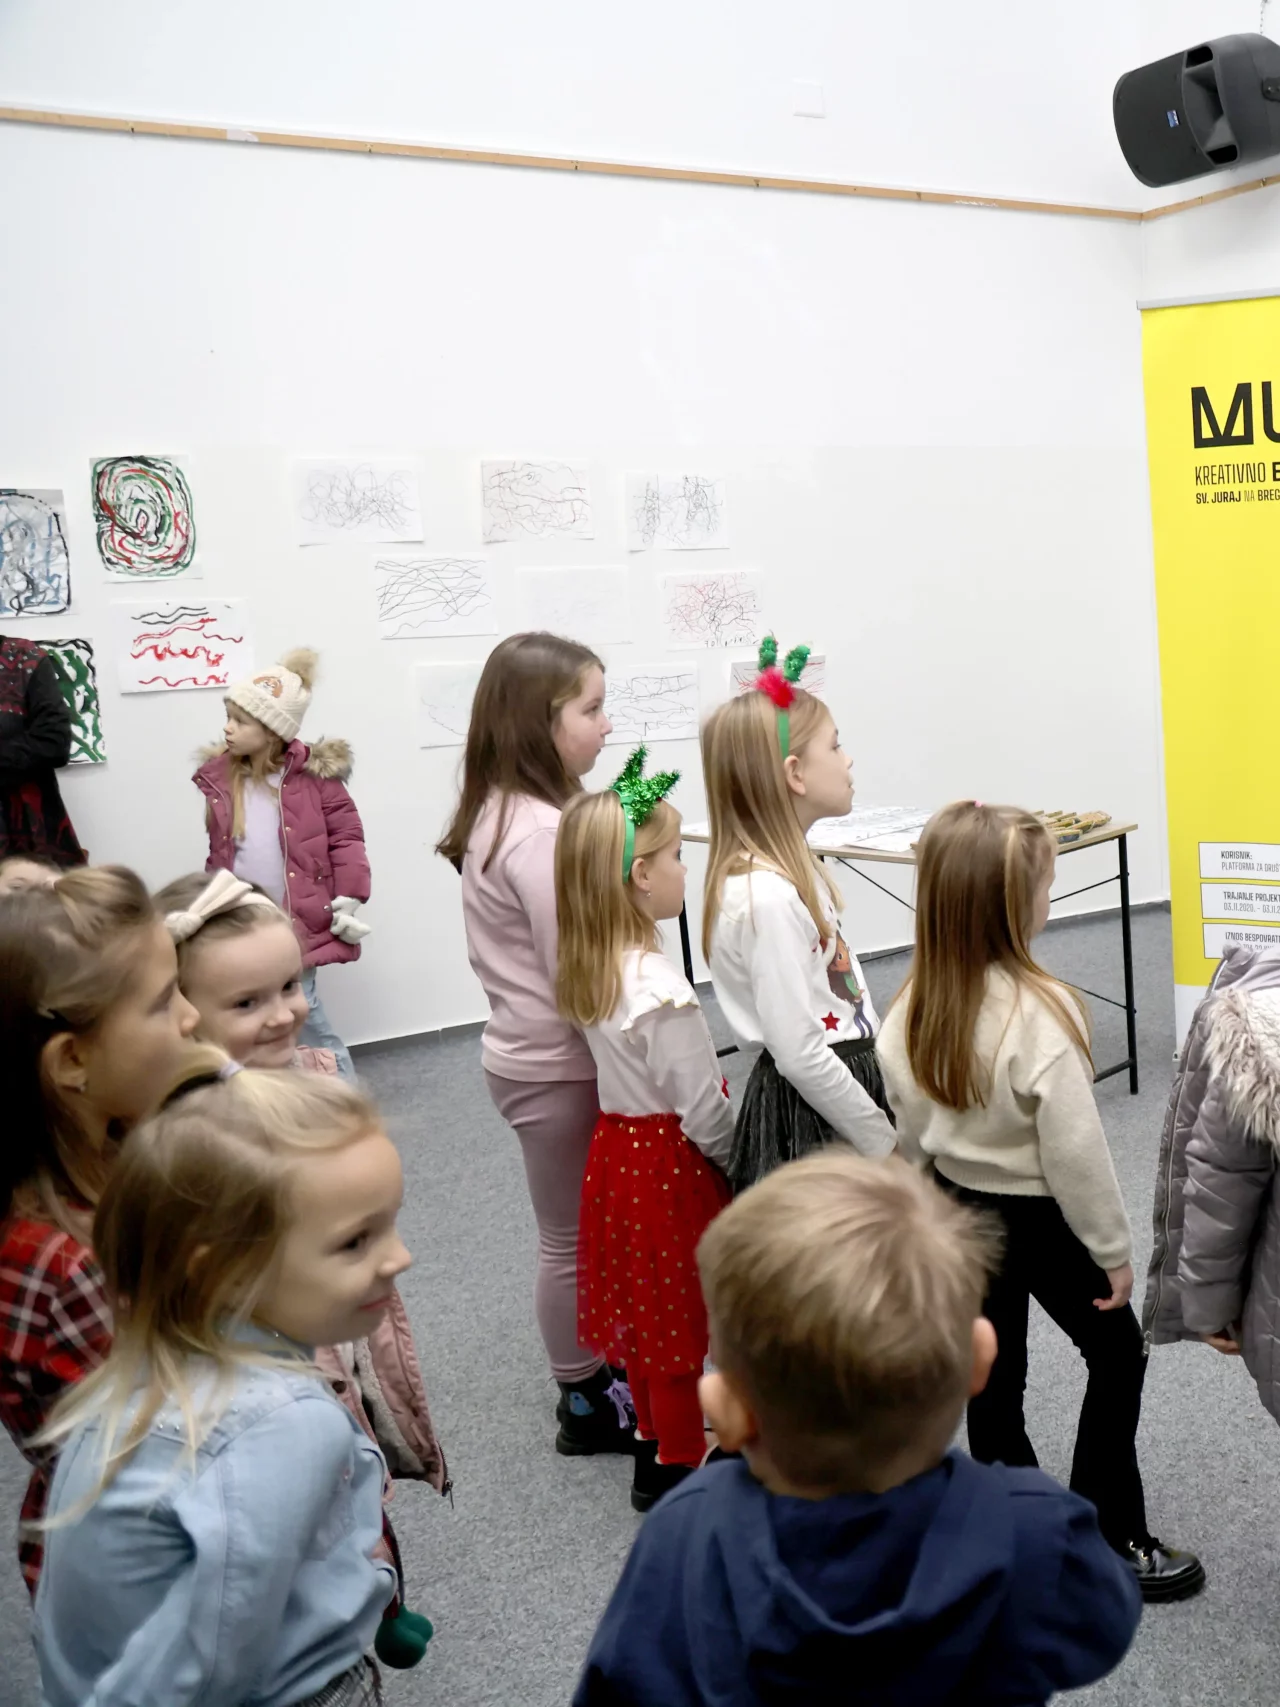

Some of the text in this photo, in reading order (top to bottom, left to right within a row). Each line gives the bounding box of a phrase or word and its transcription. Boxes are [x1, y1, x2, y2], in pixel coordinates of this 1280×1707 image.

[1195, 462, 1267, 486] KREATIVNO
[1195, 492, 1210, 505] SV.
[1211, 490, 1242, 503] JURAJ
[1243, 489, 1255, 502] NA
[1221, 850, 1253, 860] KORISNIK:
[1221, 861, 1255, 872] PLATFORMA
[1256, 862, 1264, 872] ZA
[1223, 891, 1254, 901] TRAJANJE
